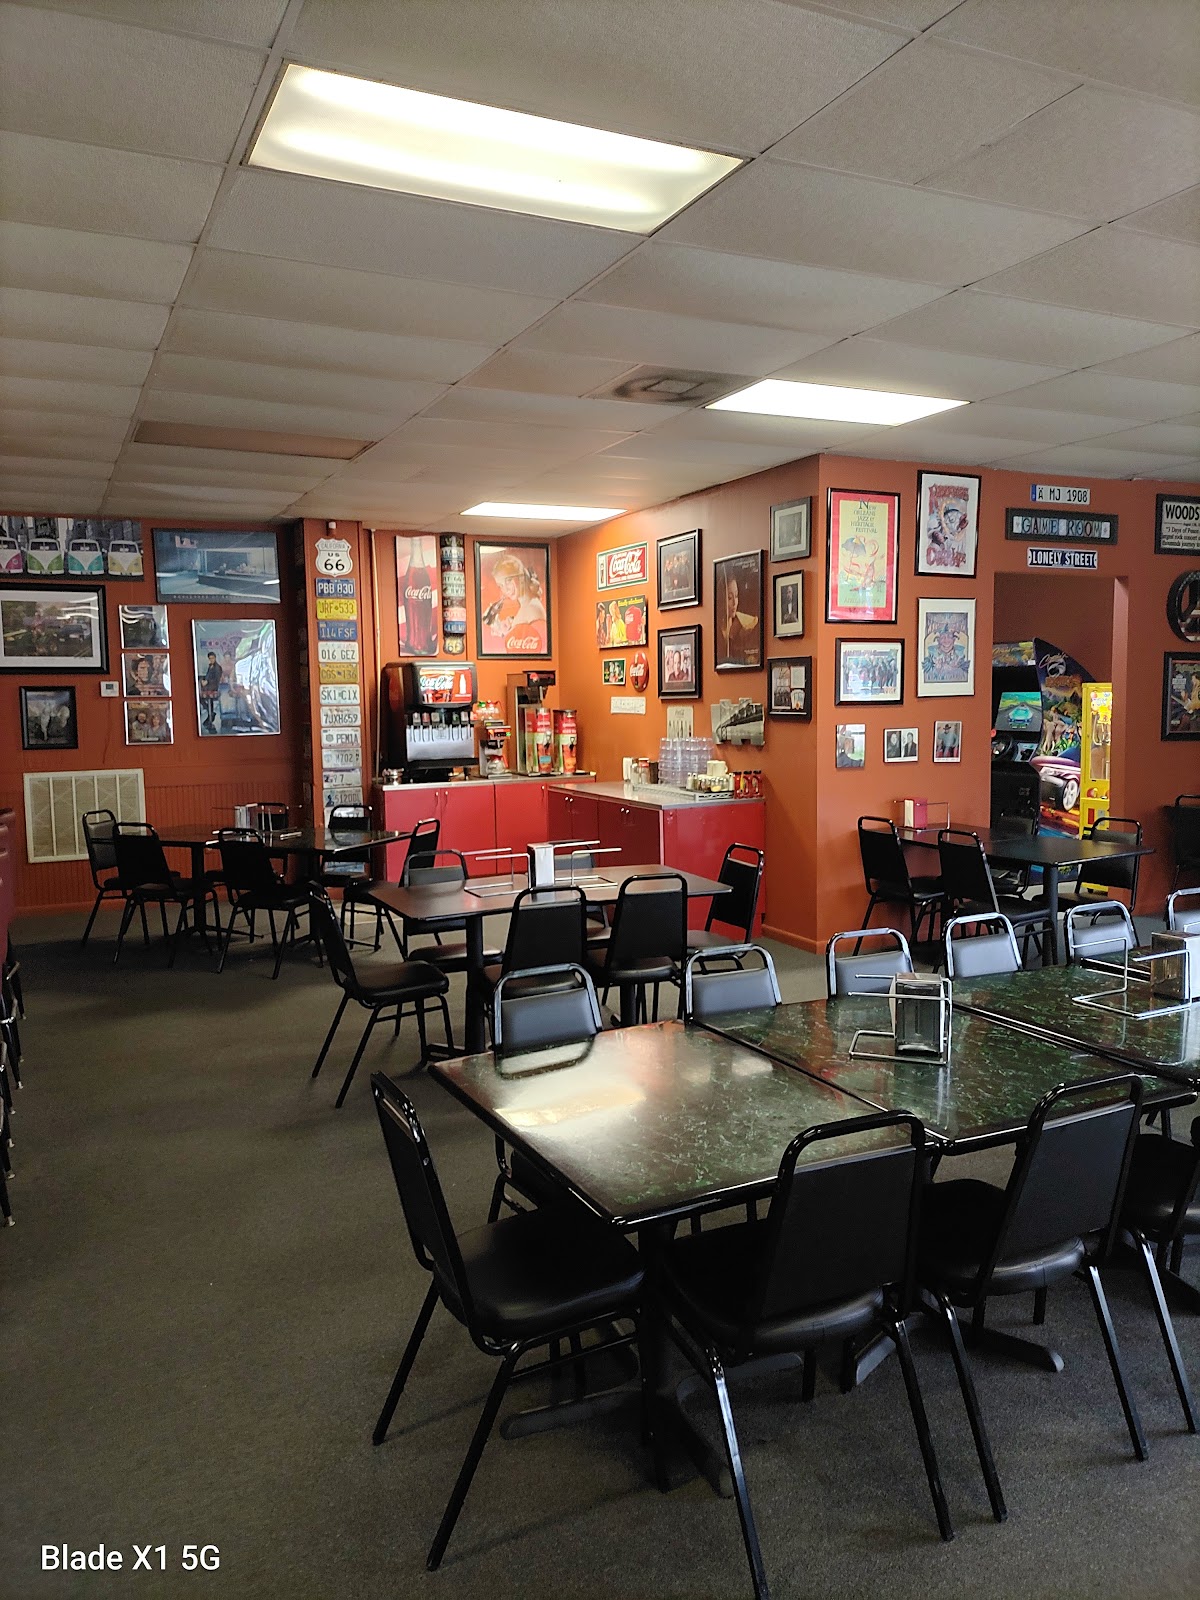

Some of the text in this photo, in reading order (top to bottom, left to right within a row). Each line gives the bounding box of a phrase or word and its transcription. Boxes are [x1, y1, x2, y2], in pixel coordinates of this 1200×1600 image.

[1049, 488, 1061, 500] MJ
[1067, 490, 1088, 503] 1908
[1022, 517, 1101, 537] GAME ROOM
[324, 559, 345, 571] 66
[1032, 551, 1094, 567] LONELY STREET
[340, 603, 354, 614] 533
